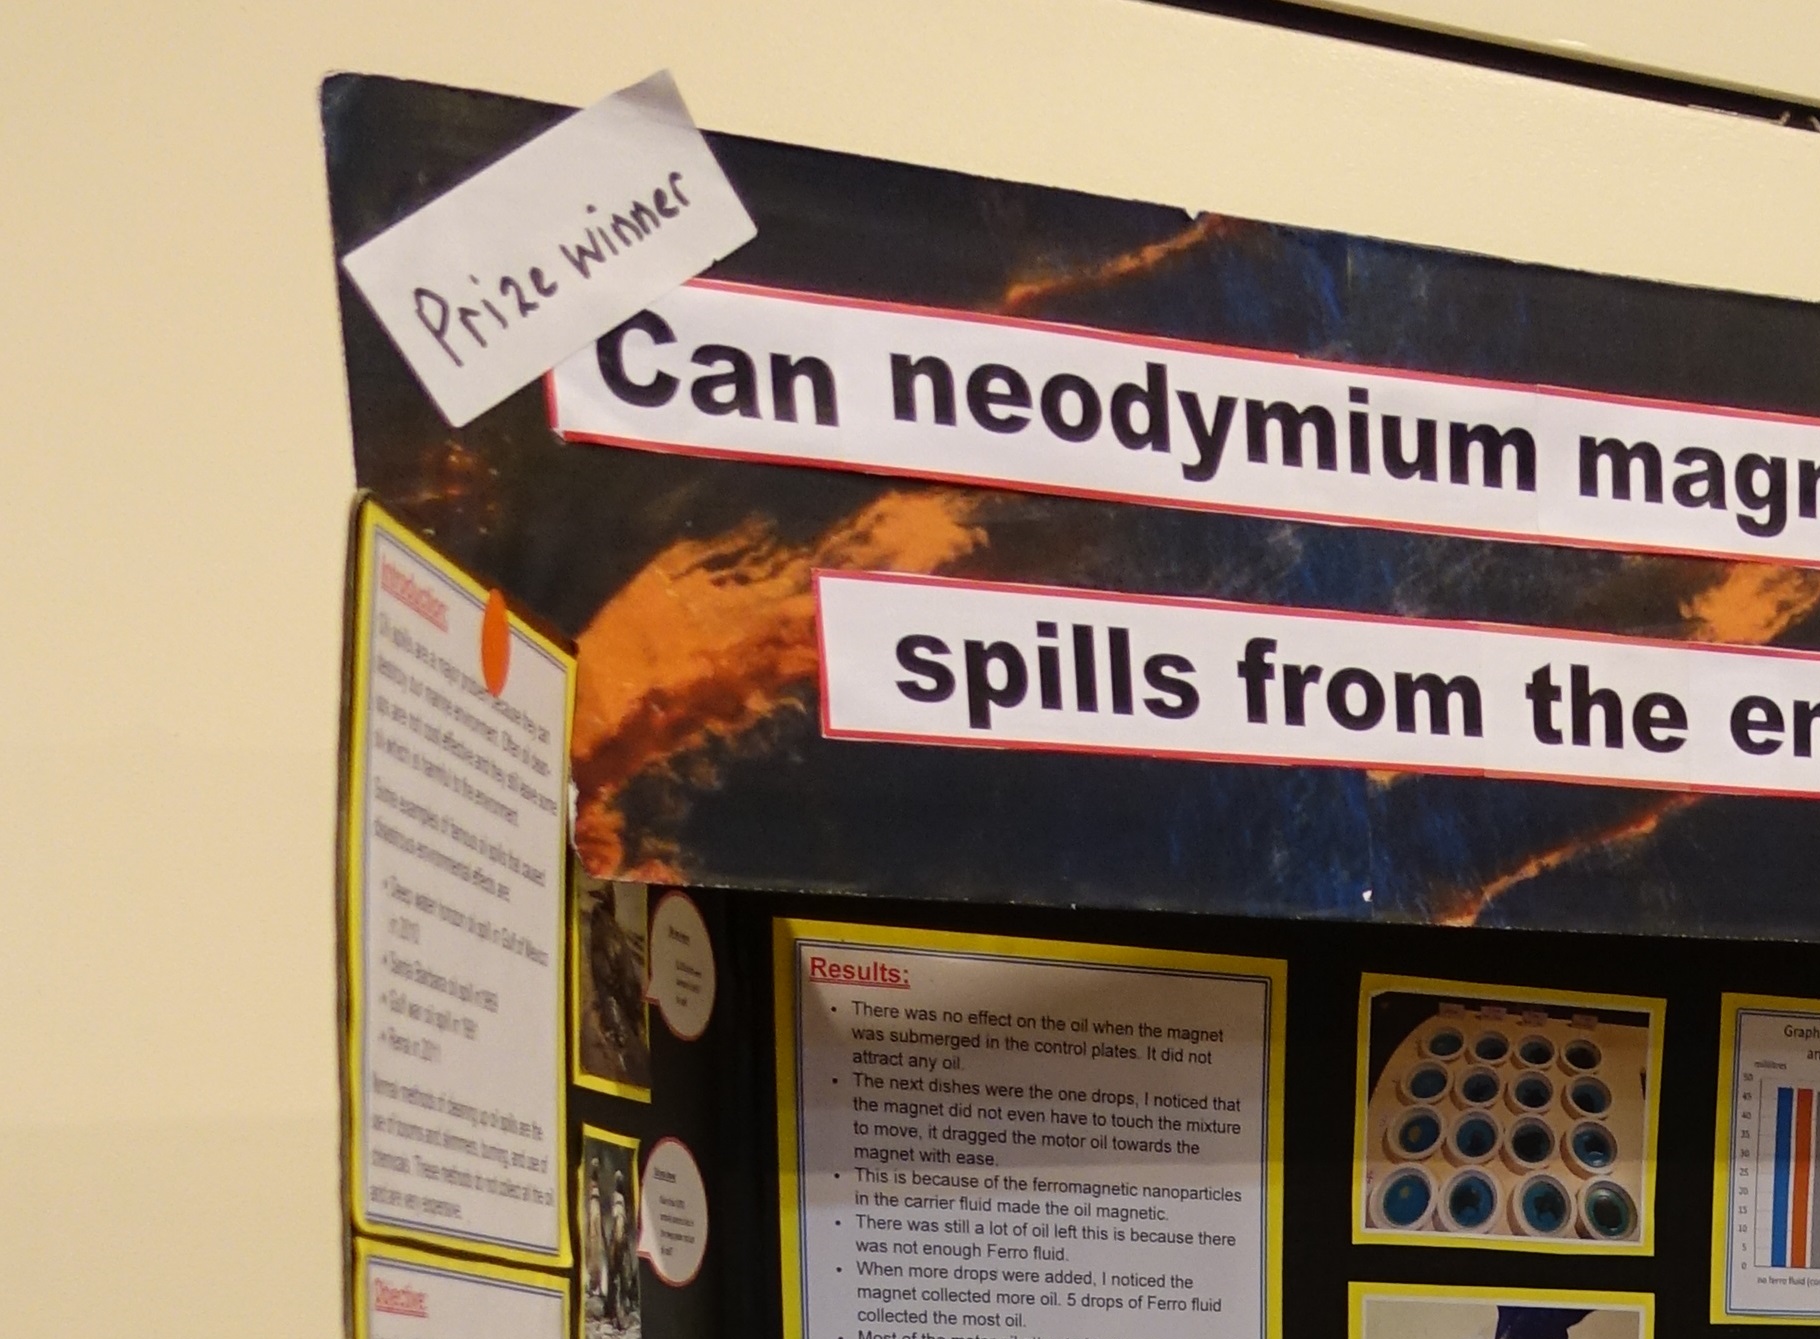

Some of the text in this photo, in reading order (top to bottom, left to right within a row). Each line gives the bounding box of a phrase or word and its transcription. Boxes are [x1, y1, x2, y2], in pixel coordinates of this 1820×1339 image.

[414, 265, 558, 367] Prize
[594, 308, 838, 427] Can
[890, 352, 1536, 492] neodymium
[895, 621, 1199, 729] spills
[1237, 637, 1483, 737] from
[1525, 663, 1688, 753] the
[810, 957, 909, 984] Results:
